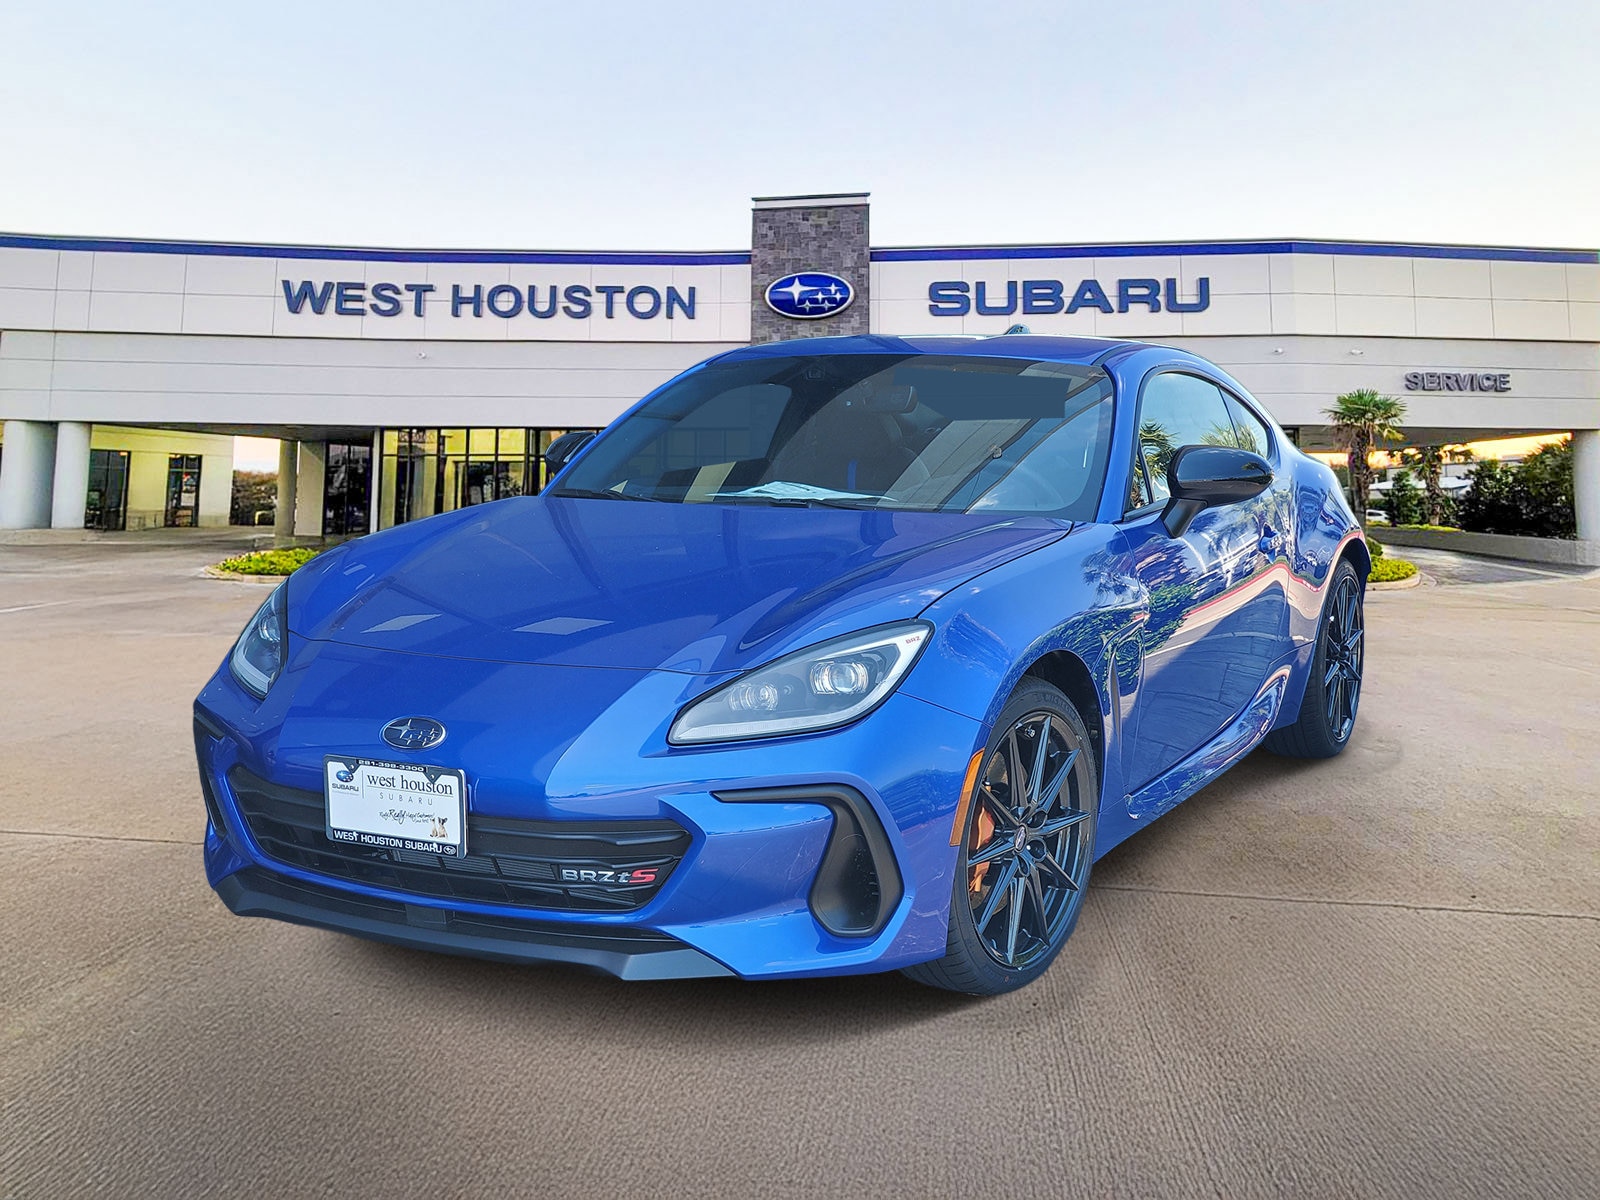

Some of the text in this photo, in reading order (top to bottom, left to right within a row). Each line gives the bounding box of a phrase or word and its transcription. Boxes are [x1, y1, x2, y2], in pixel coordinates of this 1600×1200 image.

[281, 279, 697, 319] WEST HOUSTON
[928, 277, 1210, 316] SUBARU
[1404, 371, 1512, 392] SERVICE
[331, 782, 360, 792] SUBARU
[367, 774, 453, 795] west houston
[379, 792, 433, 806] SUBARU
[333, 829, 442, 854] WEST HOUSTON SUBARU
[561, 868, 659, 884] BRZ tS
